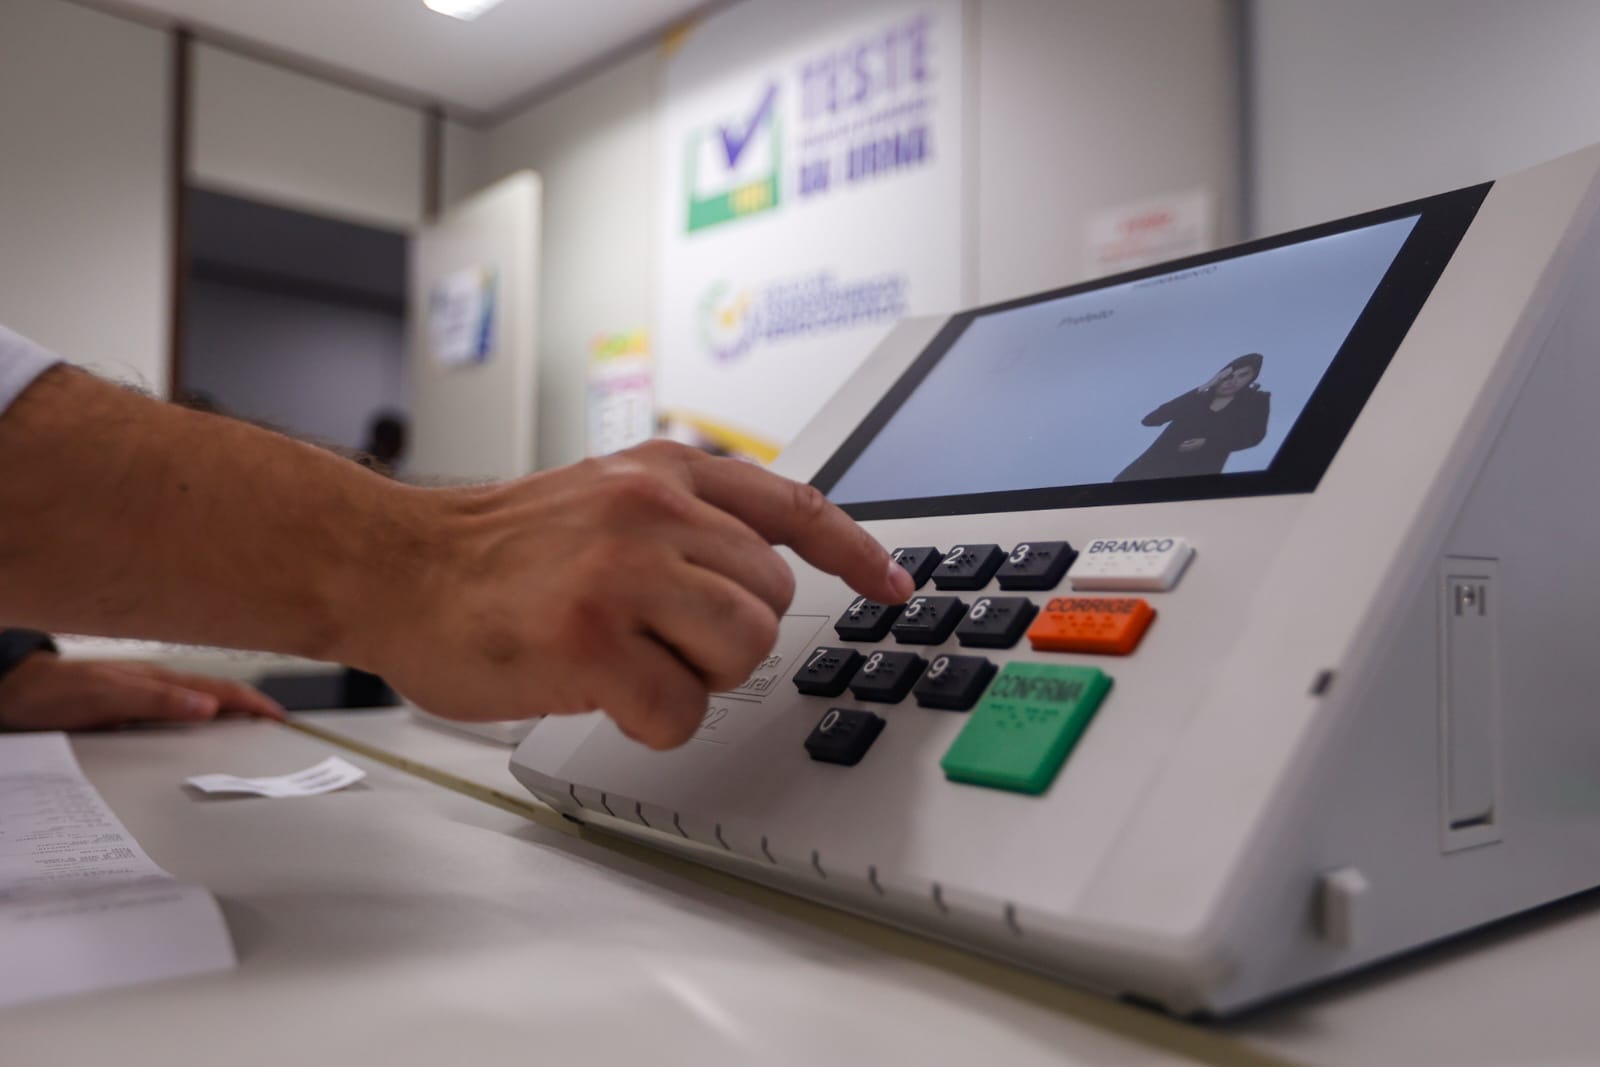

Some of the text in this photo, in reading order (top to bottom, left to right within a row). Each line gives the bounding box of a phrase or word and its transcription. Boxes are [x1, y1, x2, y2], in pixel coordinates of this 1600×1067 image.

[1009, 544, 1029, 563] 3
[1088, 538, 1174, 554] BRANCO
[943, 547, 964, 565] 2
[848, 598, 866, 615] 4
[905, 599, 926, 617] 5
[970, 599, 991, 620] 6
[1046, 598, 1139, 614] CORRIGE
[807, 649, 827, 667] 7
[863, 652, 883, 673] 8
[927, 656, 949, 678] 9
[991, 674, 1084, 702] CONFIRMA
[819, 710, 840, 732] 0
